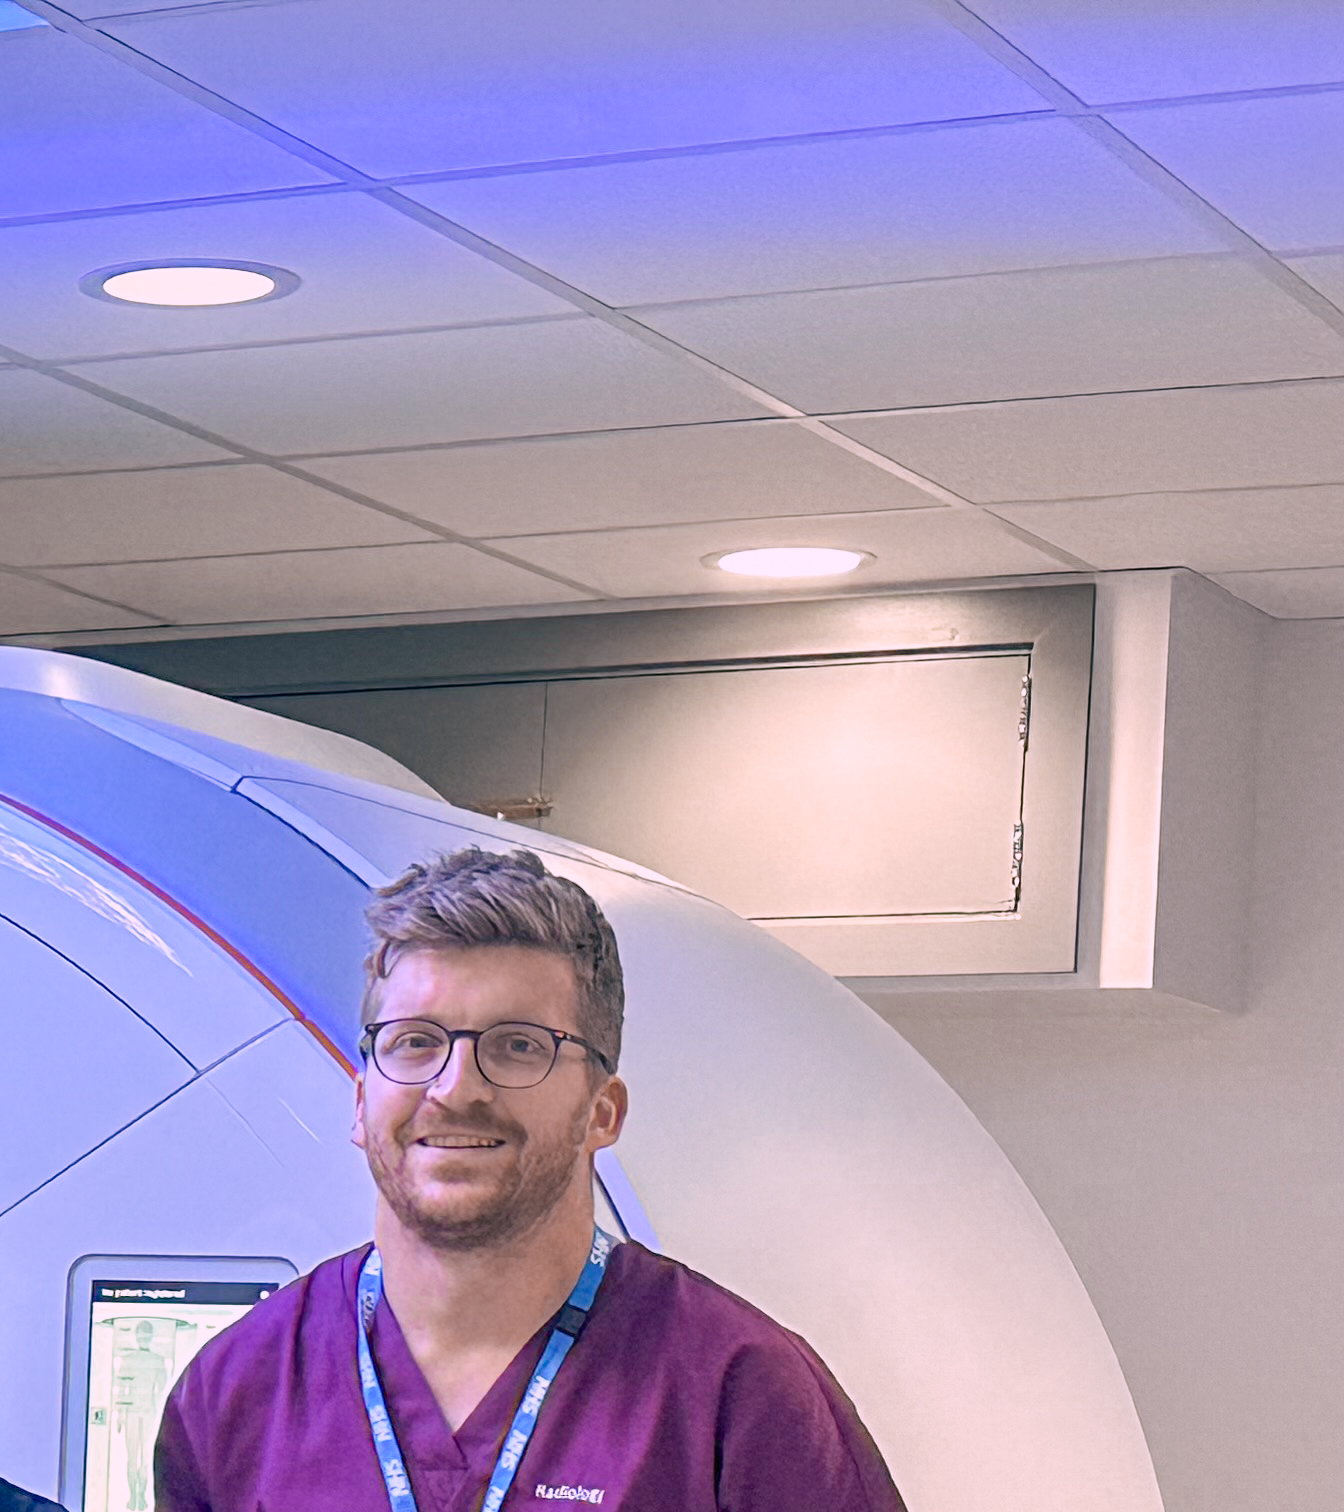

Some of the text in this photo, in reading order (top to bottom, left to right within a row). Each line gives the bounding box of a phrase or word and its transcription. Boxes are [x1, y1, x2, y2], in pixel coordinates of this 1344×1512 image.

[522, 1375, 551, 1415] NHS
[369, 1405, 392, 1441] NHS
[501, 1429, 528, 1471] NHS
[383, 1458, 410, 1497] NHS
